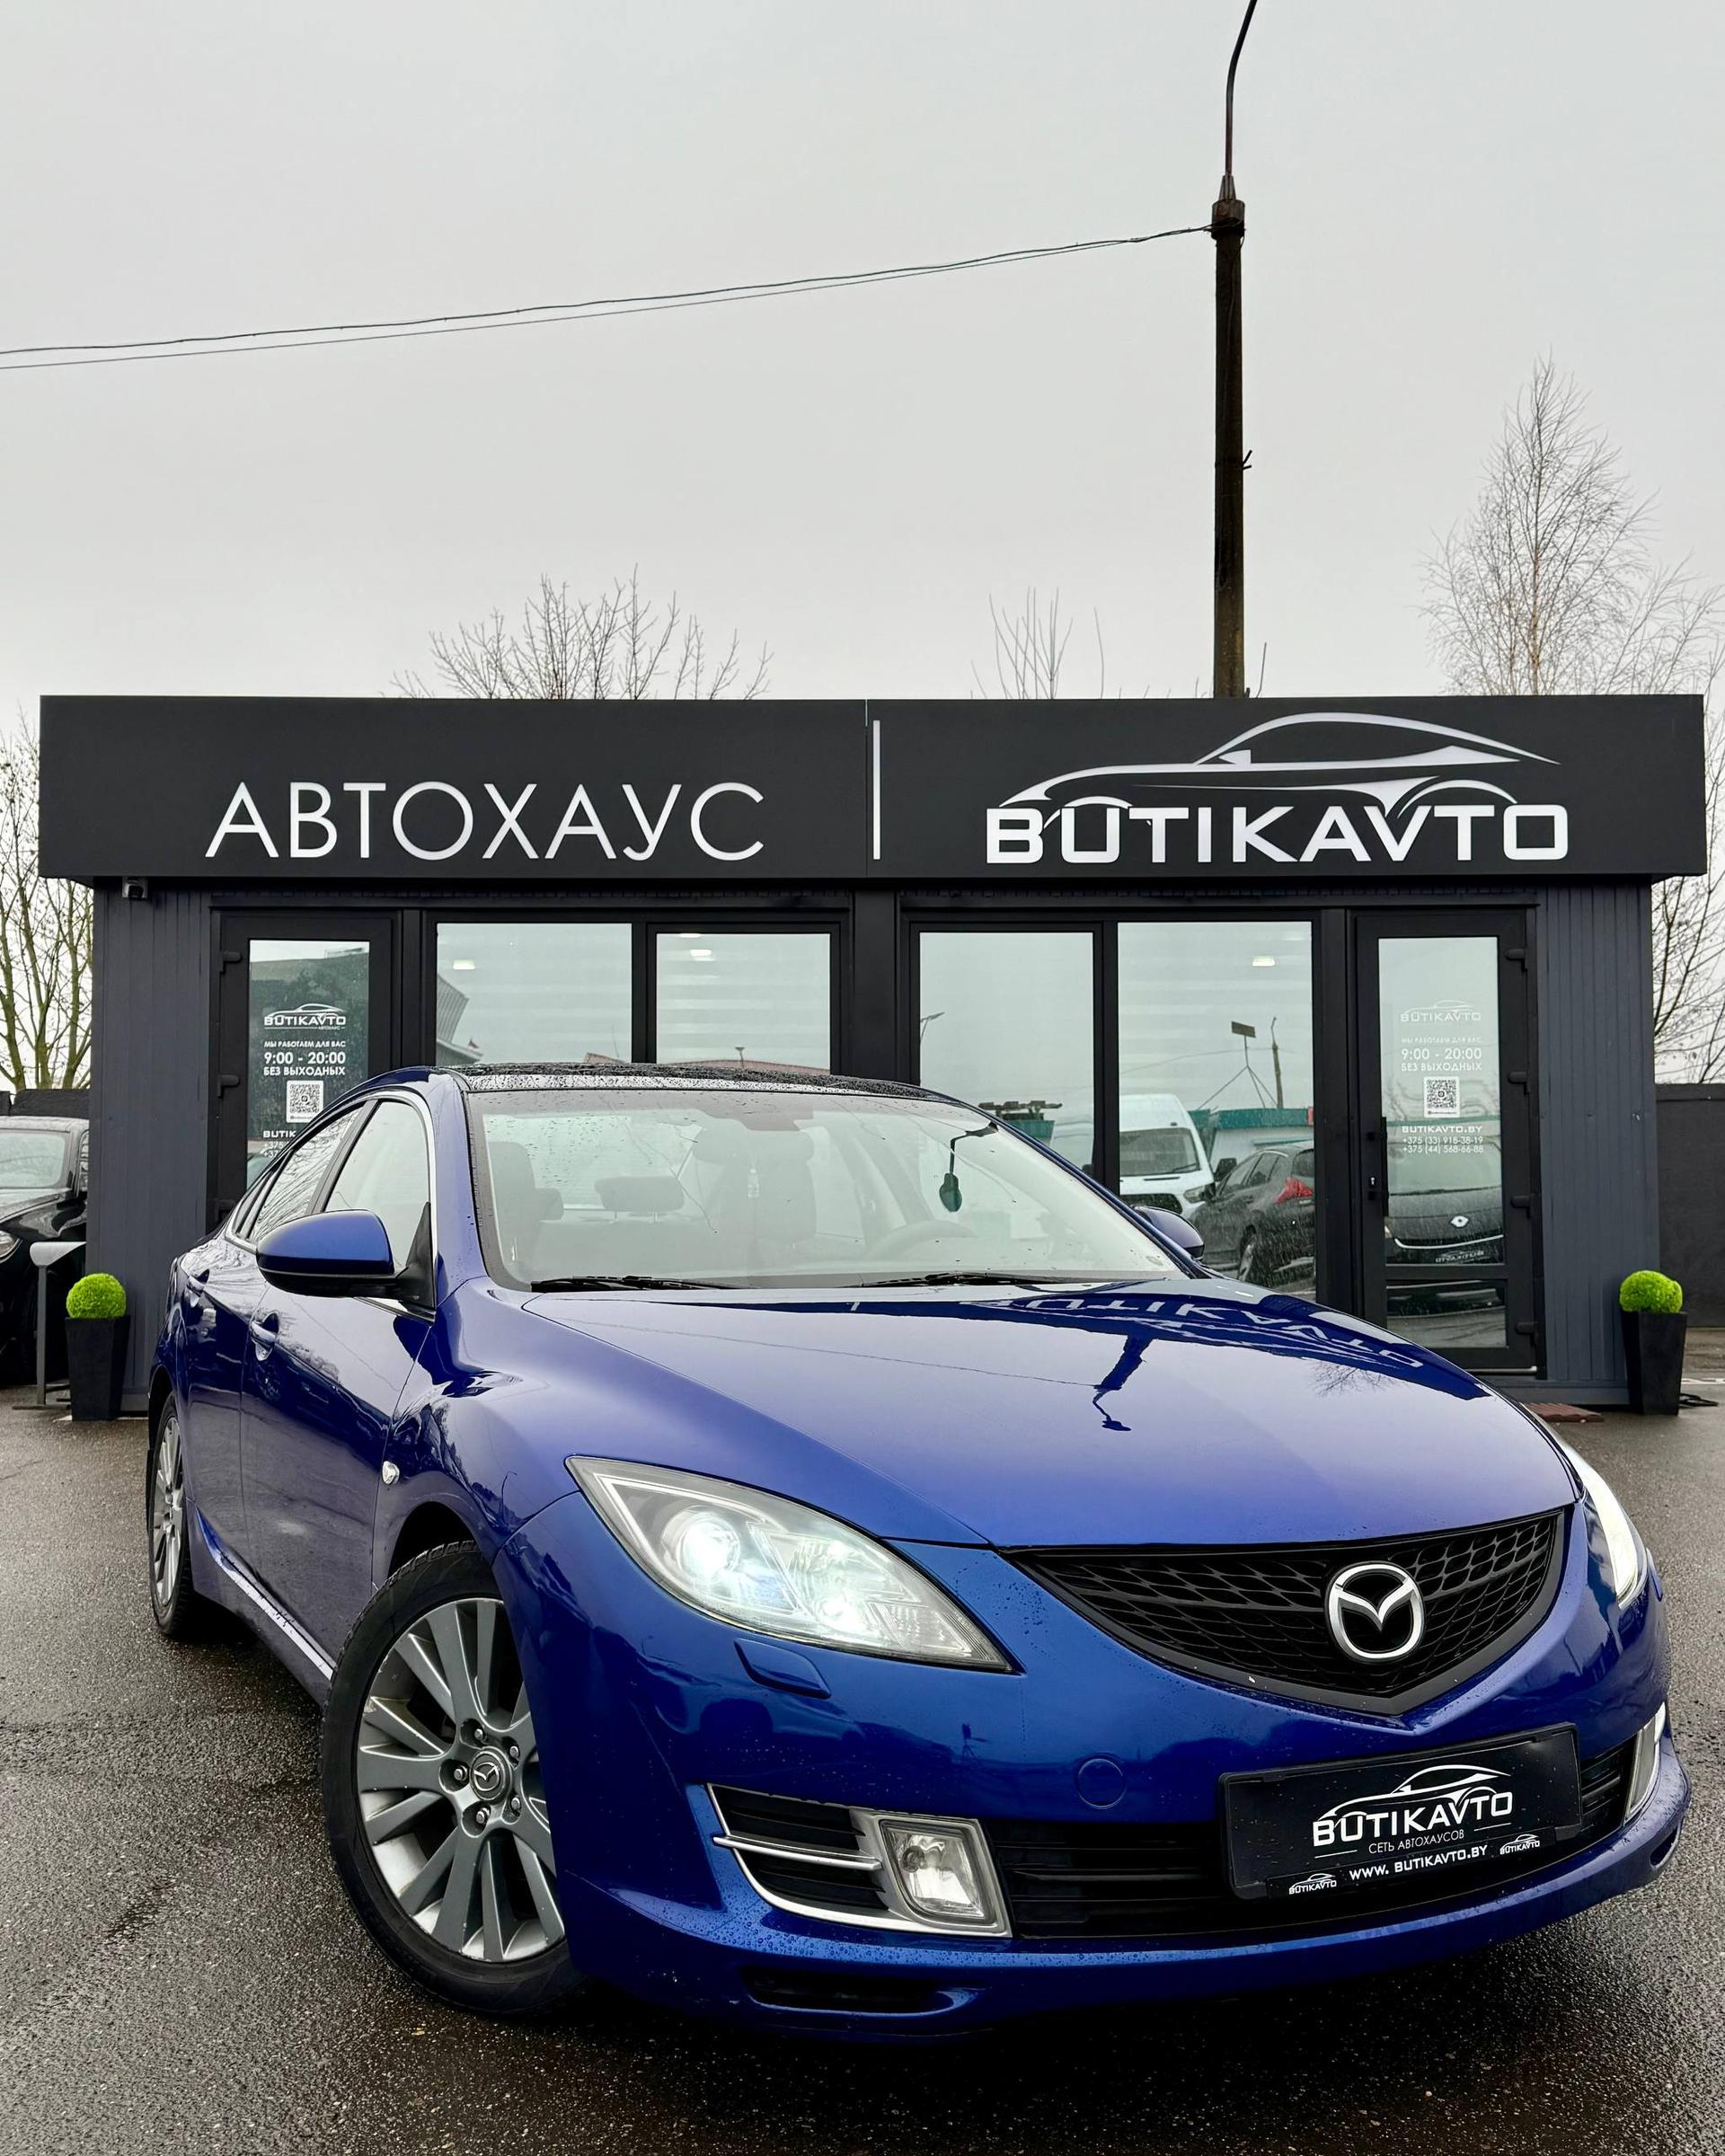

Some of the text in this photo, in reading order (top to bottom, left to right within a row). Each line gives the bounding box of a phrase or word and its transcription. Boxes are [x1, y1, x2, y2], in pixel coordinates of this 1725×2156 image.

[205, 781, 765, 862] АВТОХАУС
[986, 804, 1569, 864] BUTIKAVTO
[263, 1015, 347, 1026] BUTIKAVTO
[1401, 1012, 1482, 1022] BUTIKAVTO
[263, 1040, 347, 1048] МЫ РАБОТАЕМ ДЛЯ ВАС
[263, 1051, 294, 1065] 9:00
[307, 1051, 347, 1065] 20:00
[1401, 1047, 1430, 1061] 9:00
[1444, 1047, 1482, 1061] 20:00
[263, 1066, 347, 1076] БЕЗ ВЫХОДНЫХ
[1401, 1062, 1482, 1072] БЕЗ ВЫХОДНЫХ
[262, 1130, 297, 1138] BUTIK
[1402, 1125, 1483, 1134] BUTIKAVTO.BY
[1402, 1135, 1423, 1144] +375
[1424, 1135, 1441, 1145] (33)
[1402, 1144, 1423, 1153] +375
[1424, 1144, 1441, 1154] (44)
[1313, 1791, 1513, 1847] BUTIKAVTO
[1368, 1829, 1465, 1854] СЕТЬ АВТОХАУСОВ
[1499, 1839, 1540, 1855] BUTIKAVTO
[1349, 1844, 1489, 1881] WWW. BUTIKAVTO.BY
[1288, 1879, 1338, 1895] BUTIKAVTO
